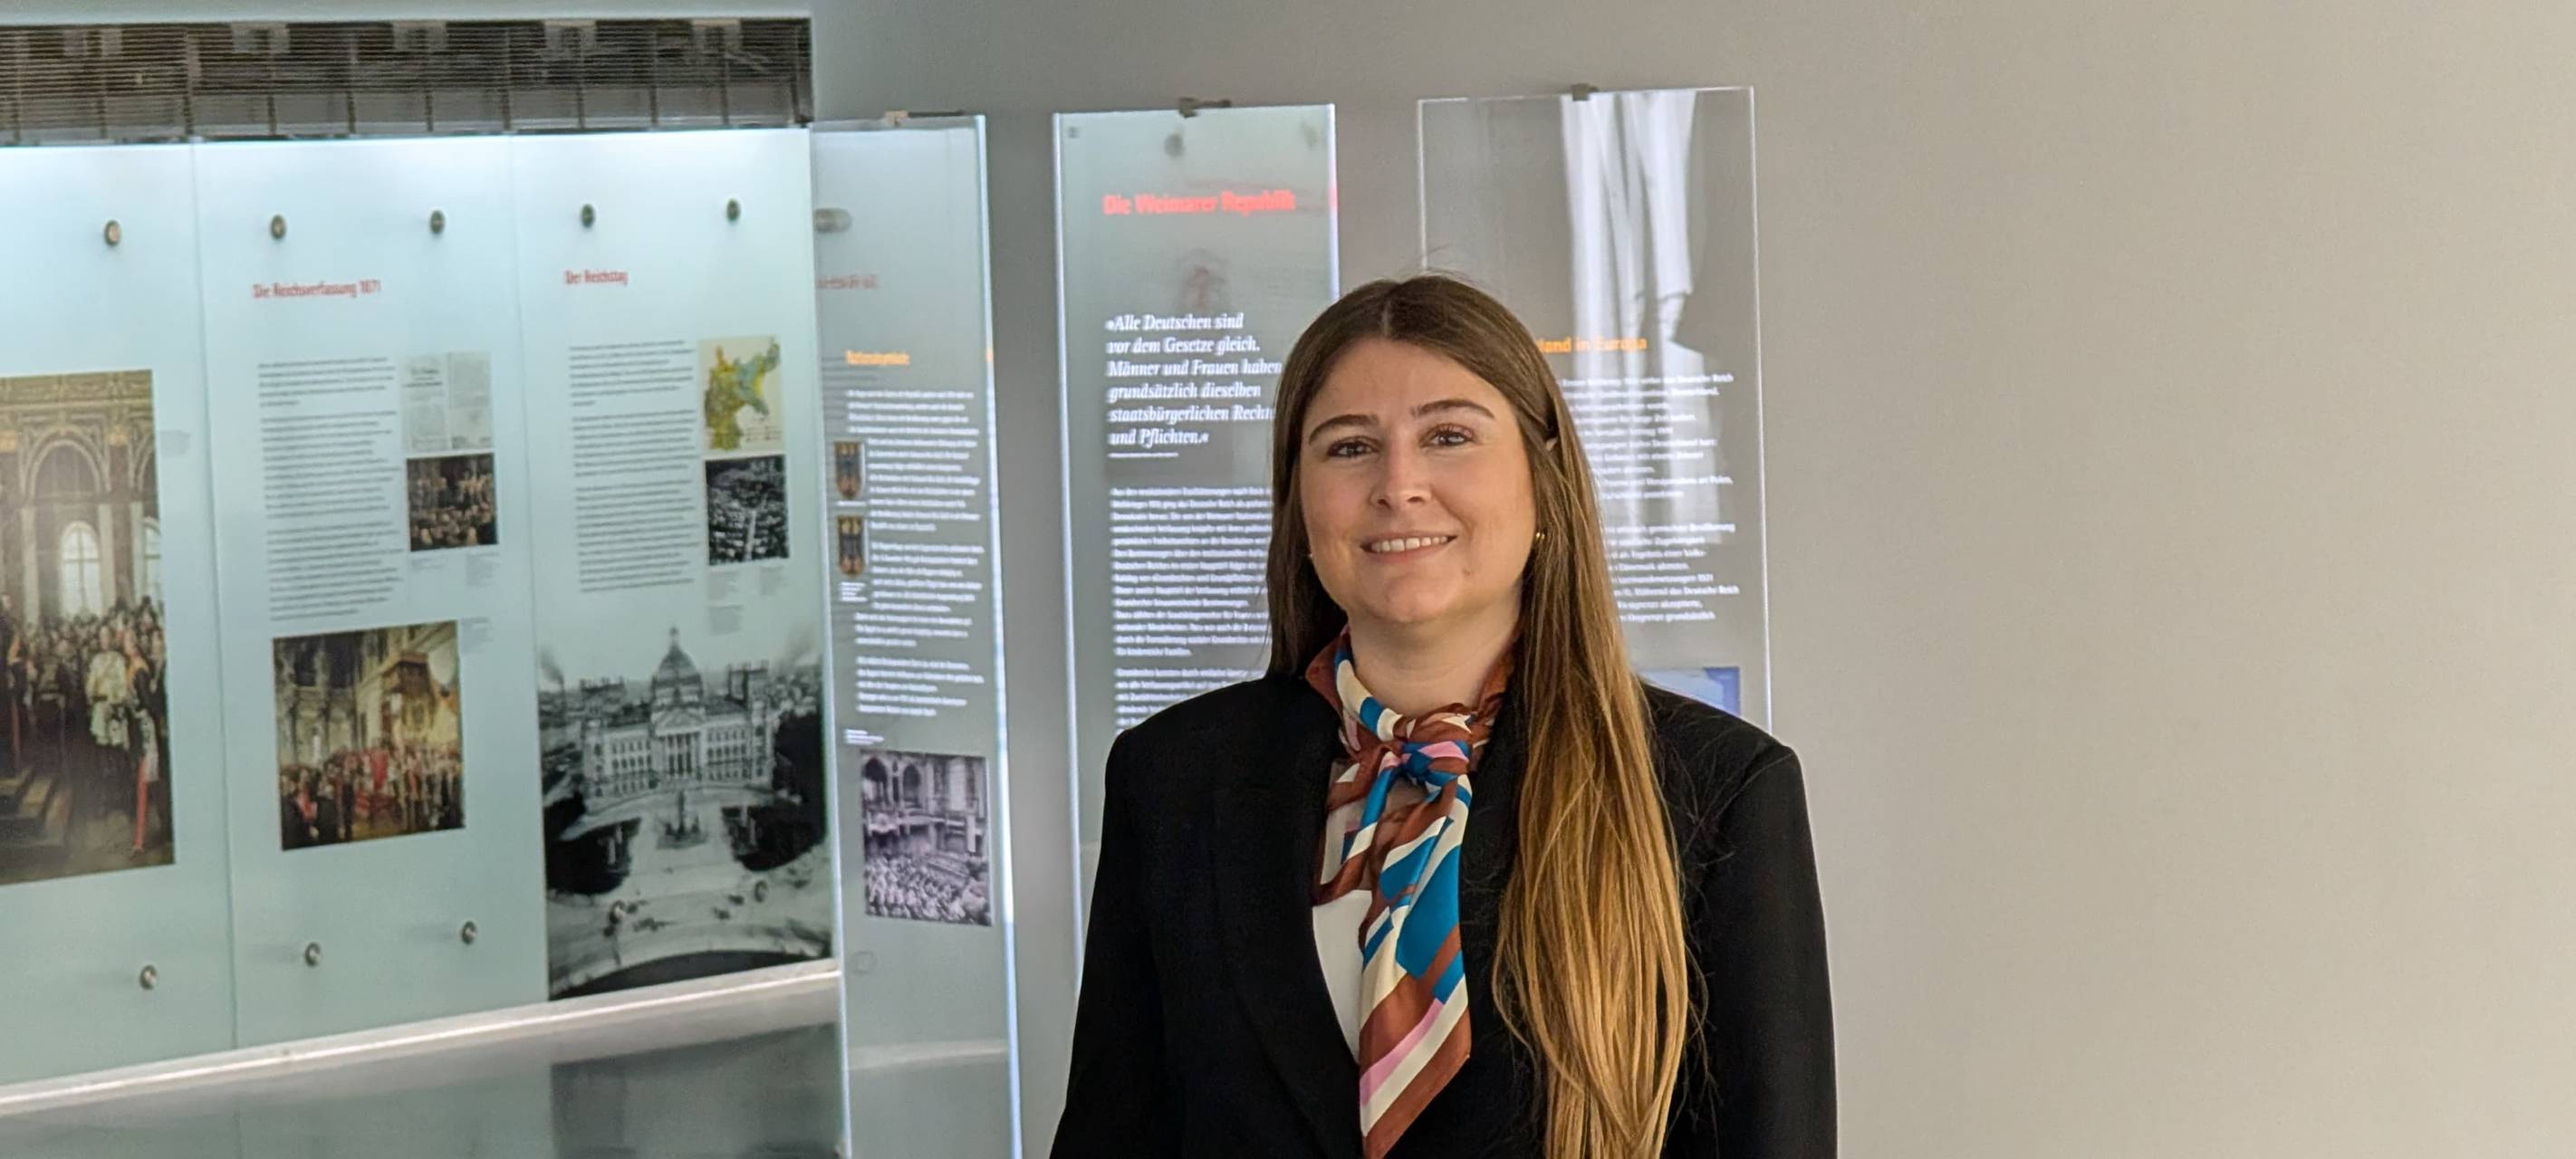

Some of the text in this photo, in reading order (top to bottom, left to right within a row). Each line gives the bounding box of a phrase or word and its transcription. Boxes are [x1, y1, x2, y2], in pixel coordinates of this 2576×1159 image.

[1103, 190, 1296, 216] Die Weimarer Republik
[1142, 314, 1211, 330] Deutschen
[1215, 312, 1244, 329] sind
[1107, 336, 1260, 355] vor dem Gesetze gleich.
[1107, 359, 1282, 377] Männer und Frauen haben
[1109, 381, 1261, 403] grundsätzlich dieselben
[1109, 406, 1229, 425] staatsbürgerlichen
[1110, 429, 1136, 445] und
